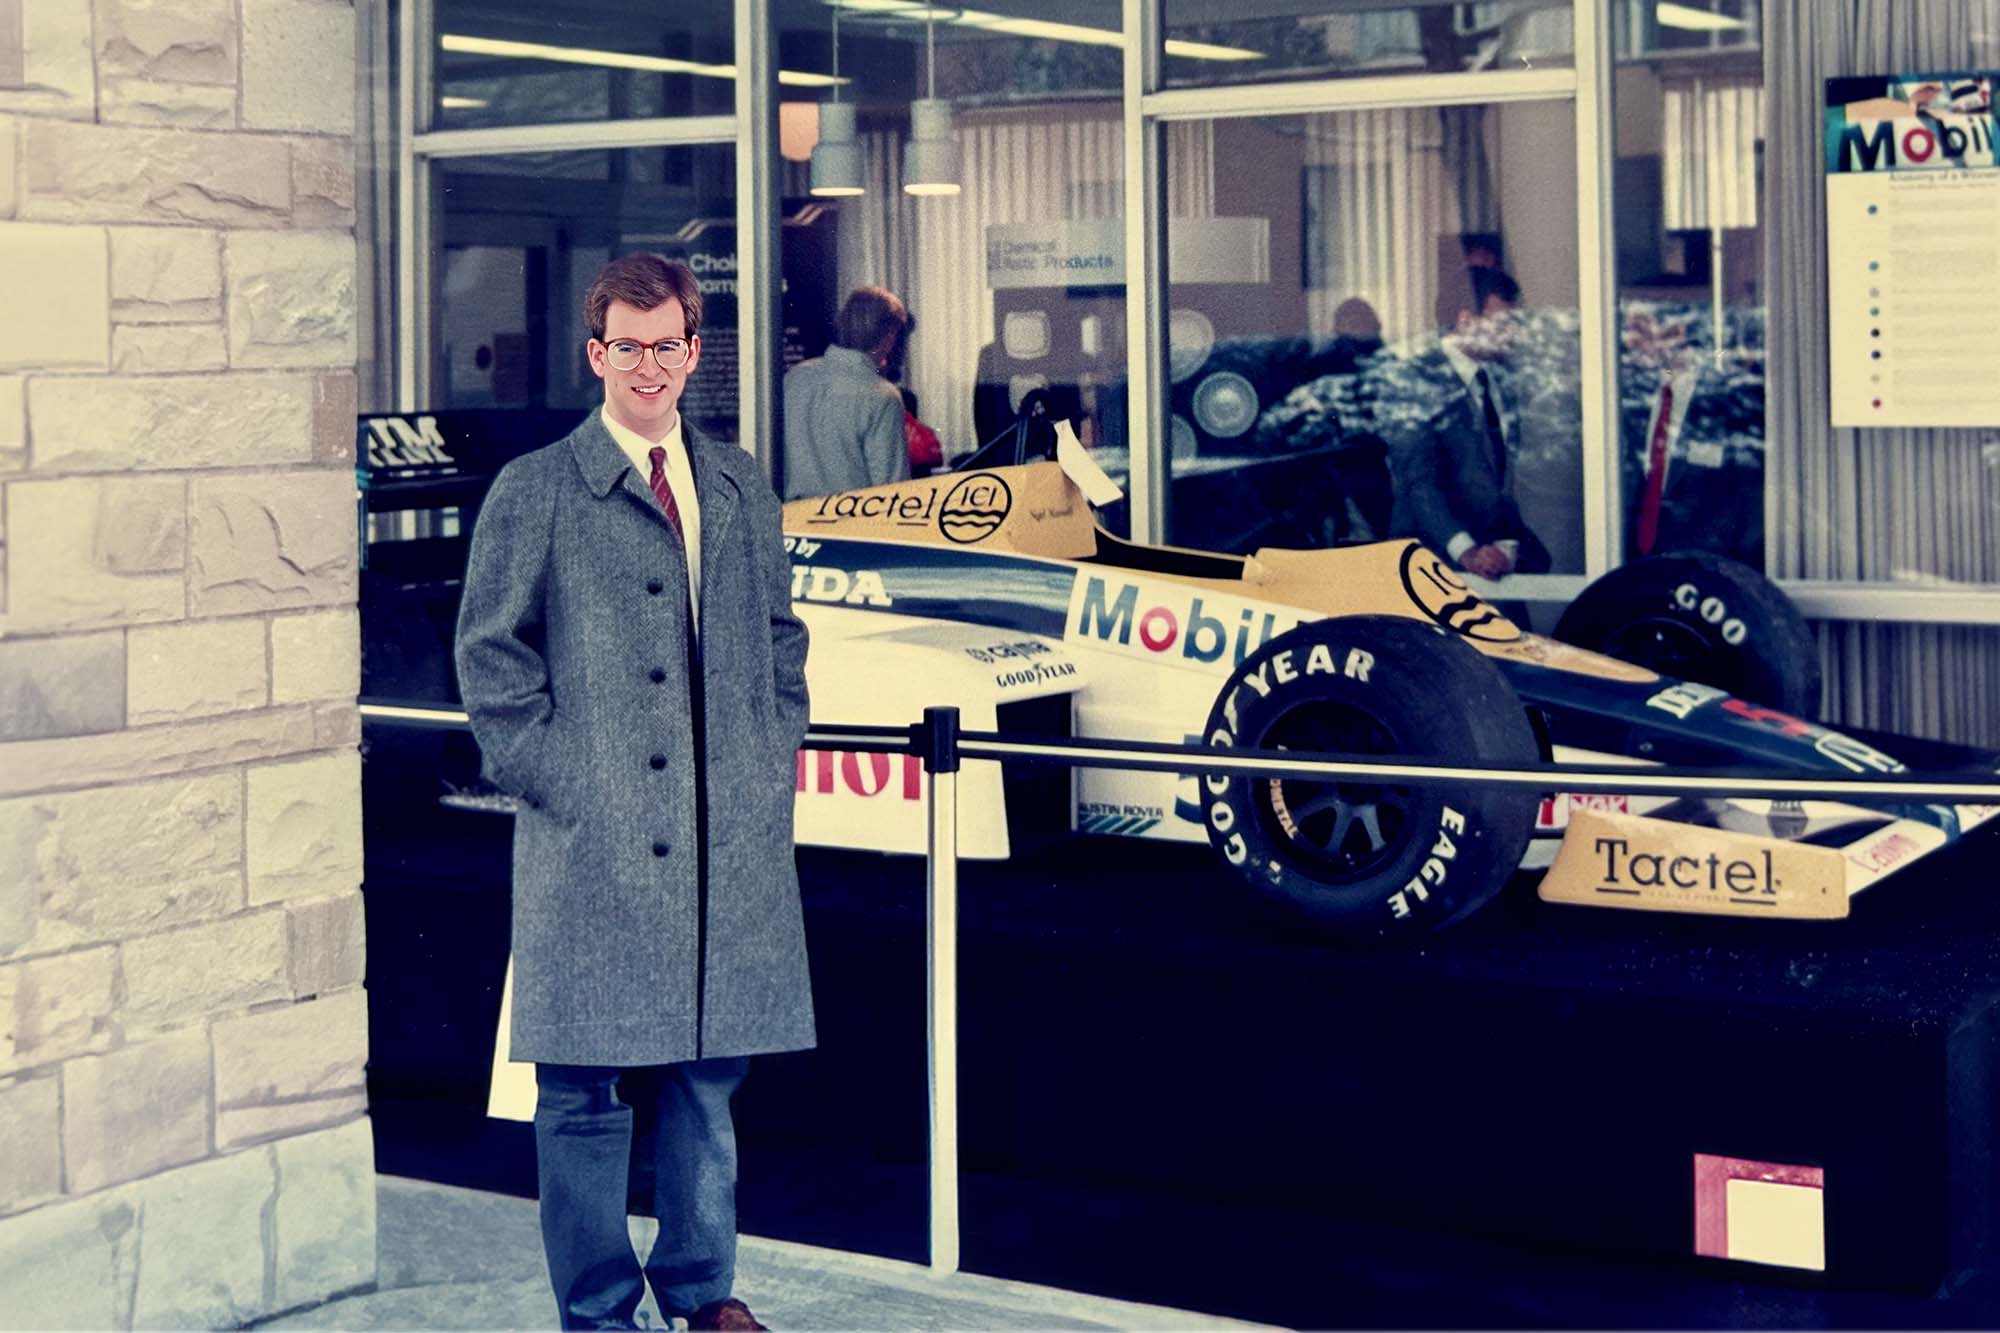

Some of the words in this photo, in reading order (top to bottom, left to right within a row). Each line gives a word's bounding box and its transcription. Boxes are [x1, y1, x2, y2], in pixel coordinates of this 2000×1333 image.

[1838, 114, 1994, 172] Mobil
[689, 252, 738, 273] Choi
[960, 485, 998, 508] ICI
[996, 661, 1077, 688] GOODYEAR
[1123, 803, 1164, 818] ROVER
[1386, 805, 1467, 919] EAGLE
[1594, 837, 1778, 896] Tactel
